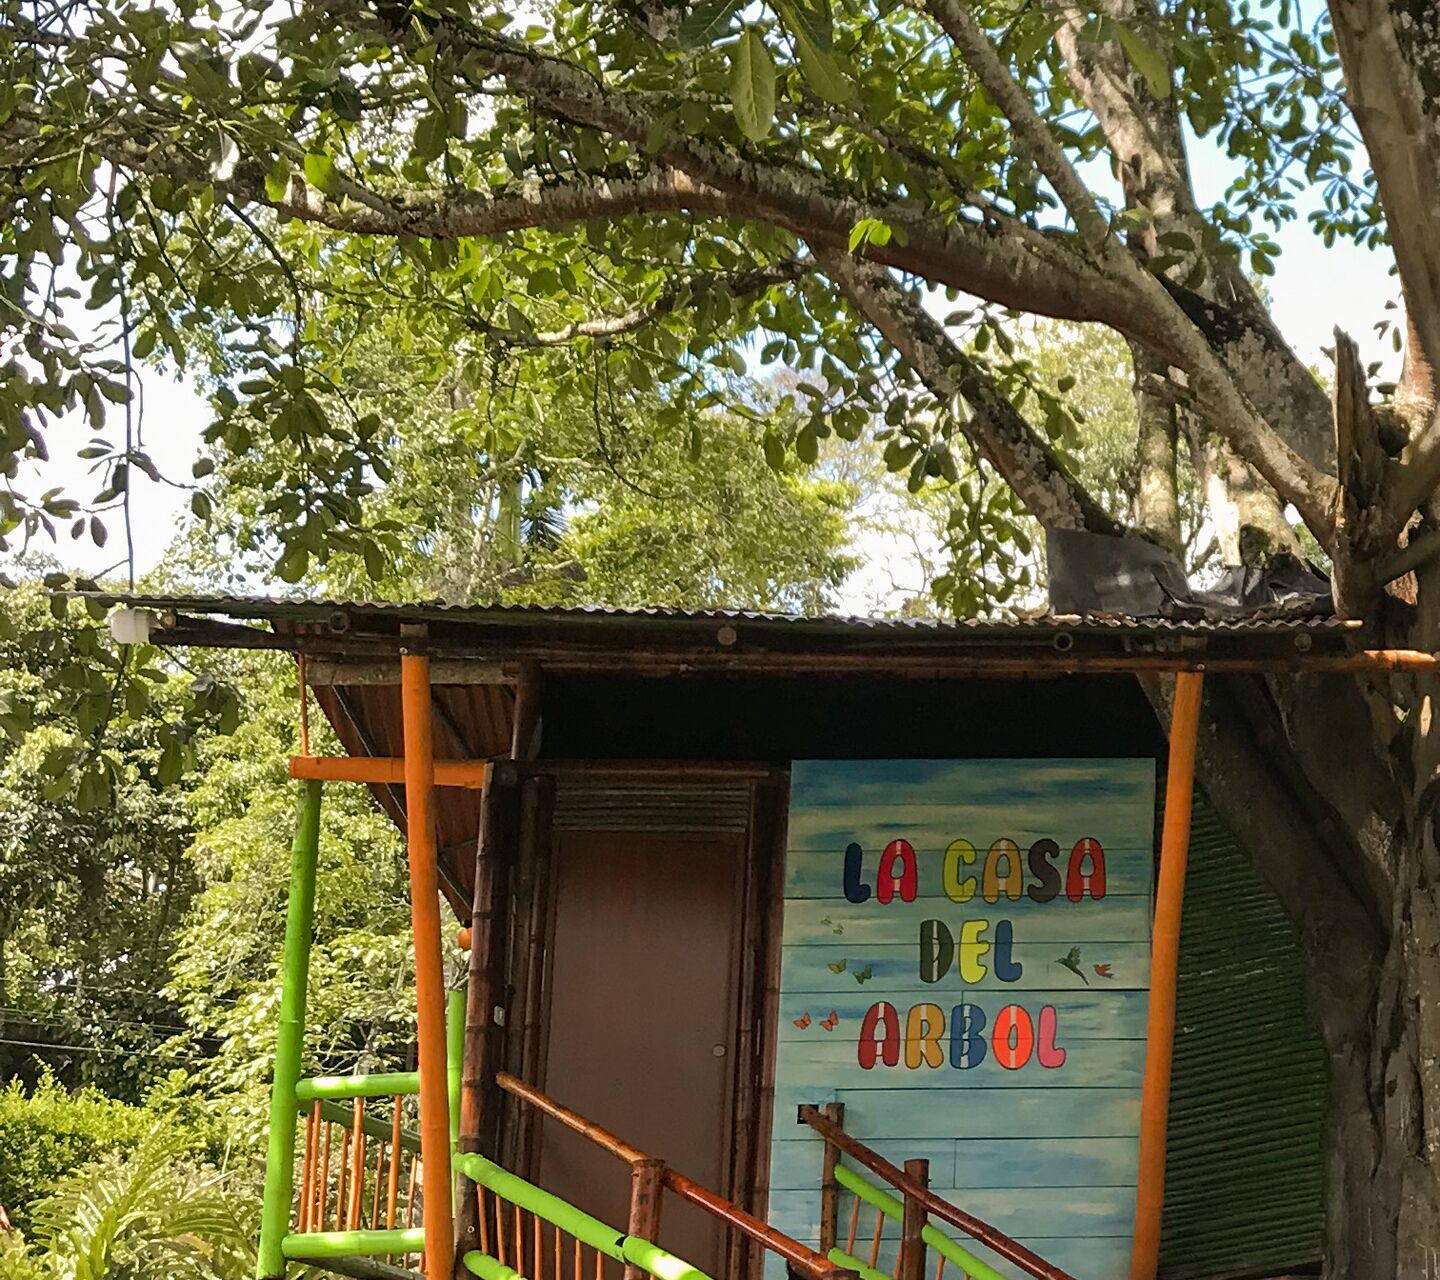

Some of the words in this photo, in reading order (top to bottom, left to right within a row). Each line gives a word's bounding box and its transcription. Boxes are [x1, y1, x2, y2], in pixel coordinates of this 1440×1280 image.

[843, 838, 918, 905] LA
[942, 837, 1107, 904] CASA
[919, 919, 1023, 984] DEL
[857, 1001, 1067, 1070] ARBOL
